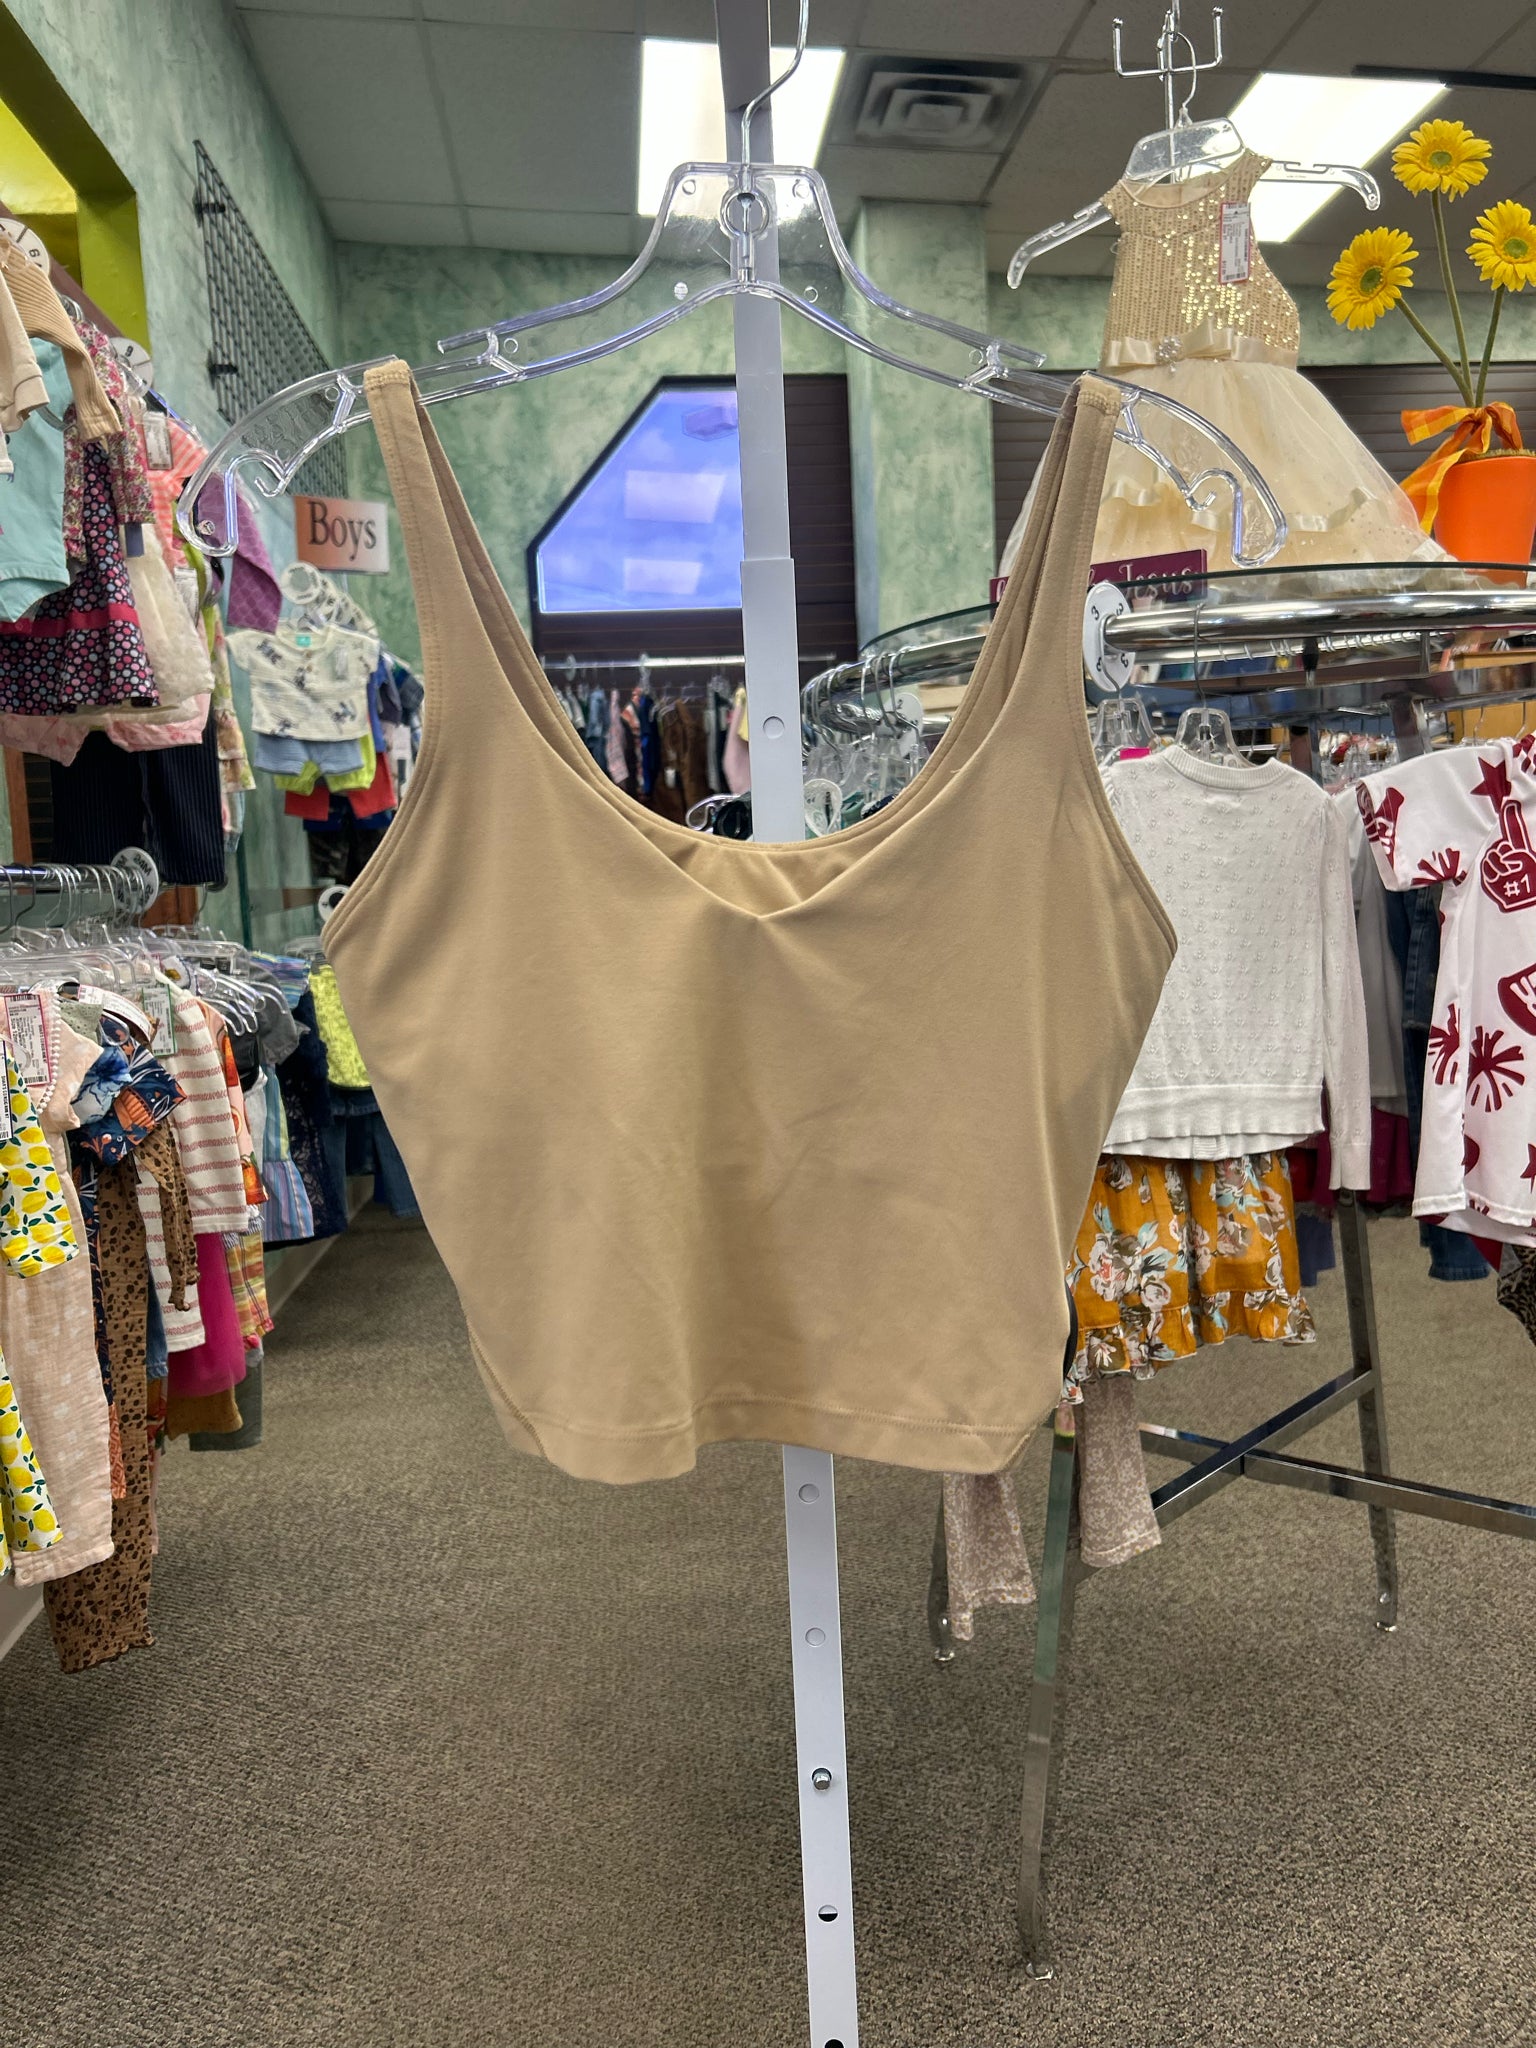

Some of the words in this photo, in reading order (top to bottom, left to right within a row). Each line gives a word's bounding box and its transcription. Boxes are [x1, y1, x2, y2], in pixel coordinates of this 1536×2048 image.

[307, 500, 378, 562] Boys
[1091, 605, 1100, 620] 3
[1503, 873, 1531, 898] #1
